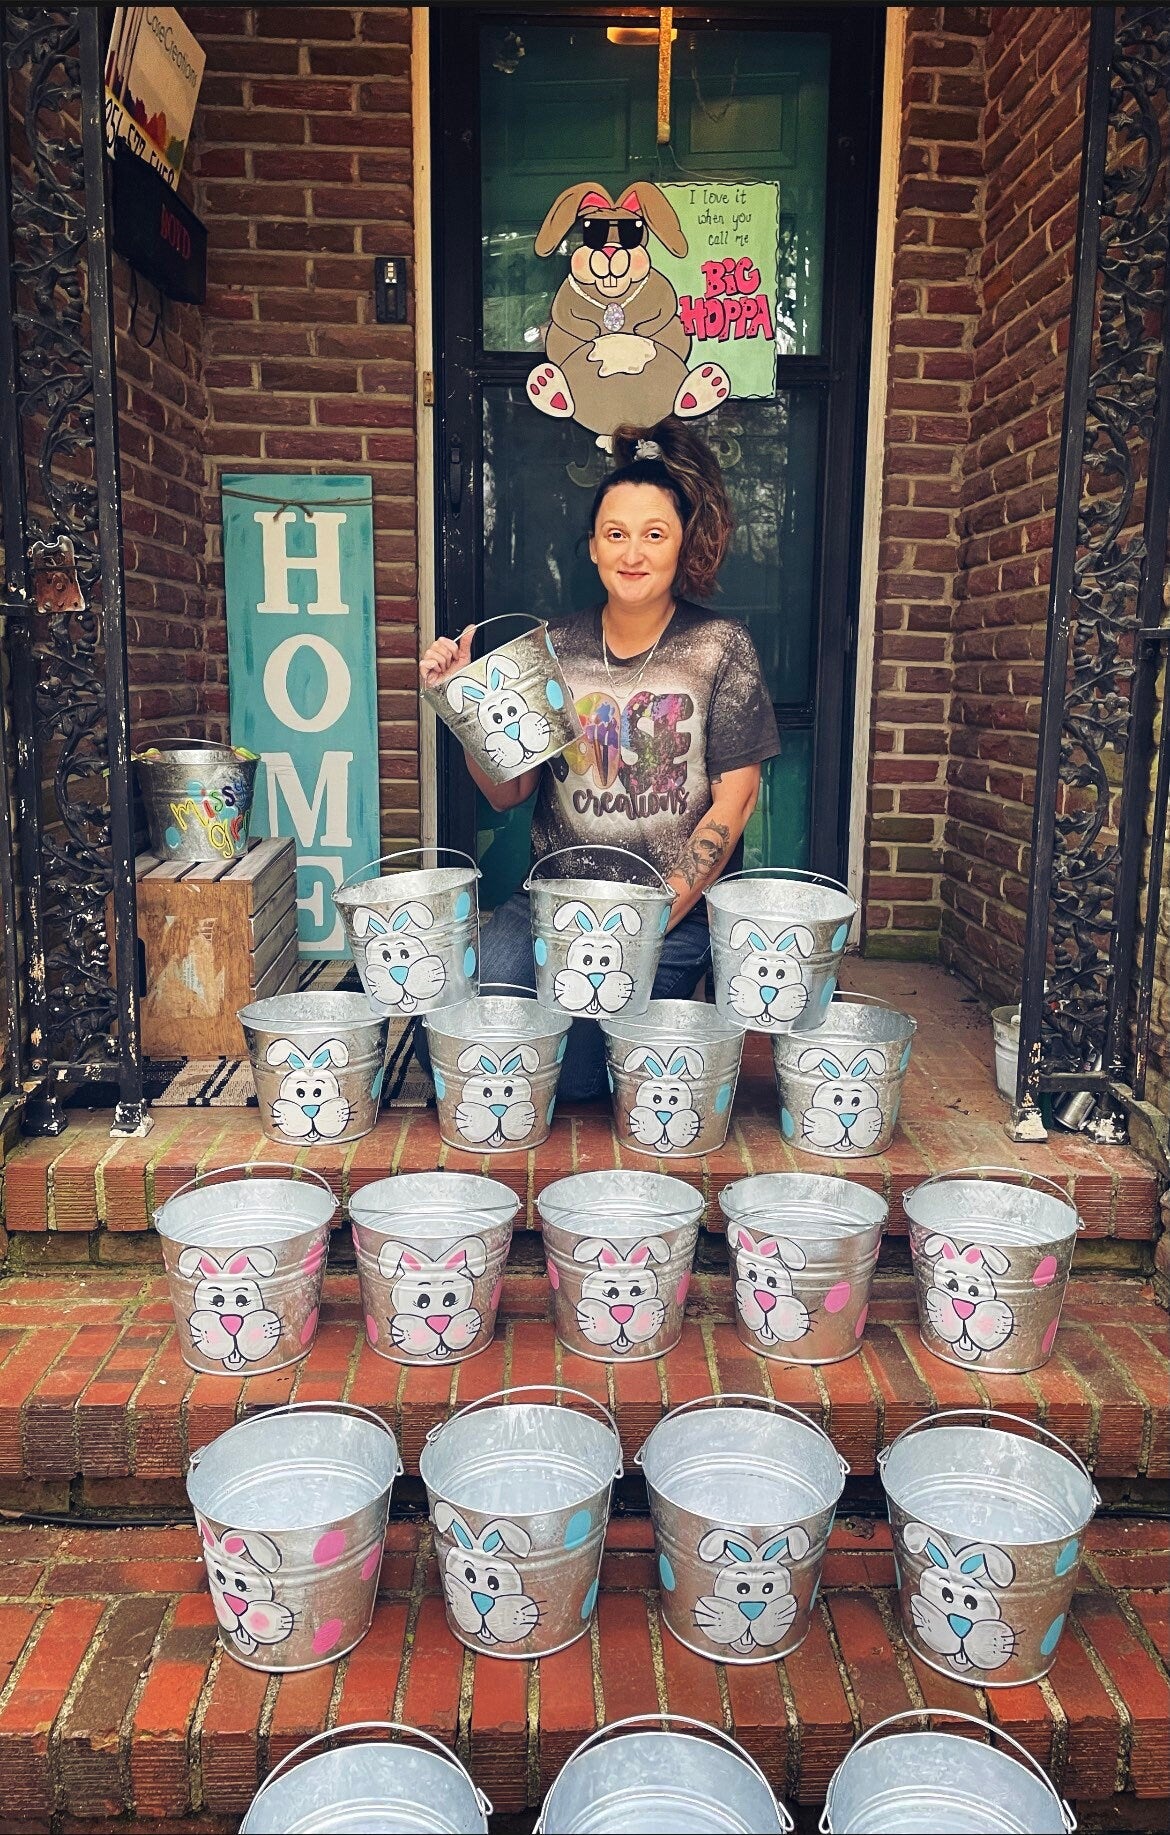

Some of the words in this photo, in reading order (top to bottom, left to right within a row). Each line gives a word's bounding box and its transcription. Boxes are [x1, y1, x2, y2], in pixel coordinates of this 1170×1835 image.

[689, 189, 696, 205] I
[703, 189, 730, 205] love
[735, 189, 748, 205] it
[697, 208, 725, 225] when
[732, 213, 752, 231] you
[708, 231, 729, 246] call
[735, 234, 749, 247] me
[679, 294, 775, 342] HOPPA
[547, 690, 695, 796] ASE
